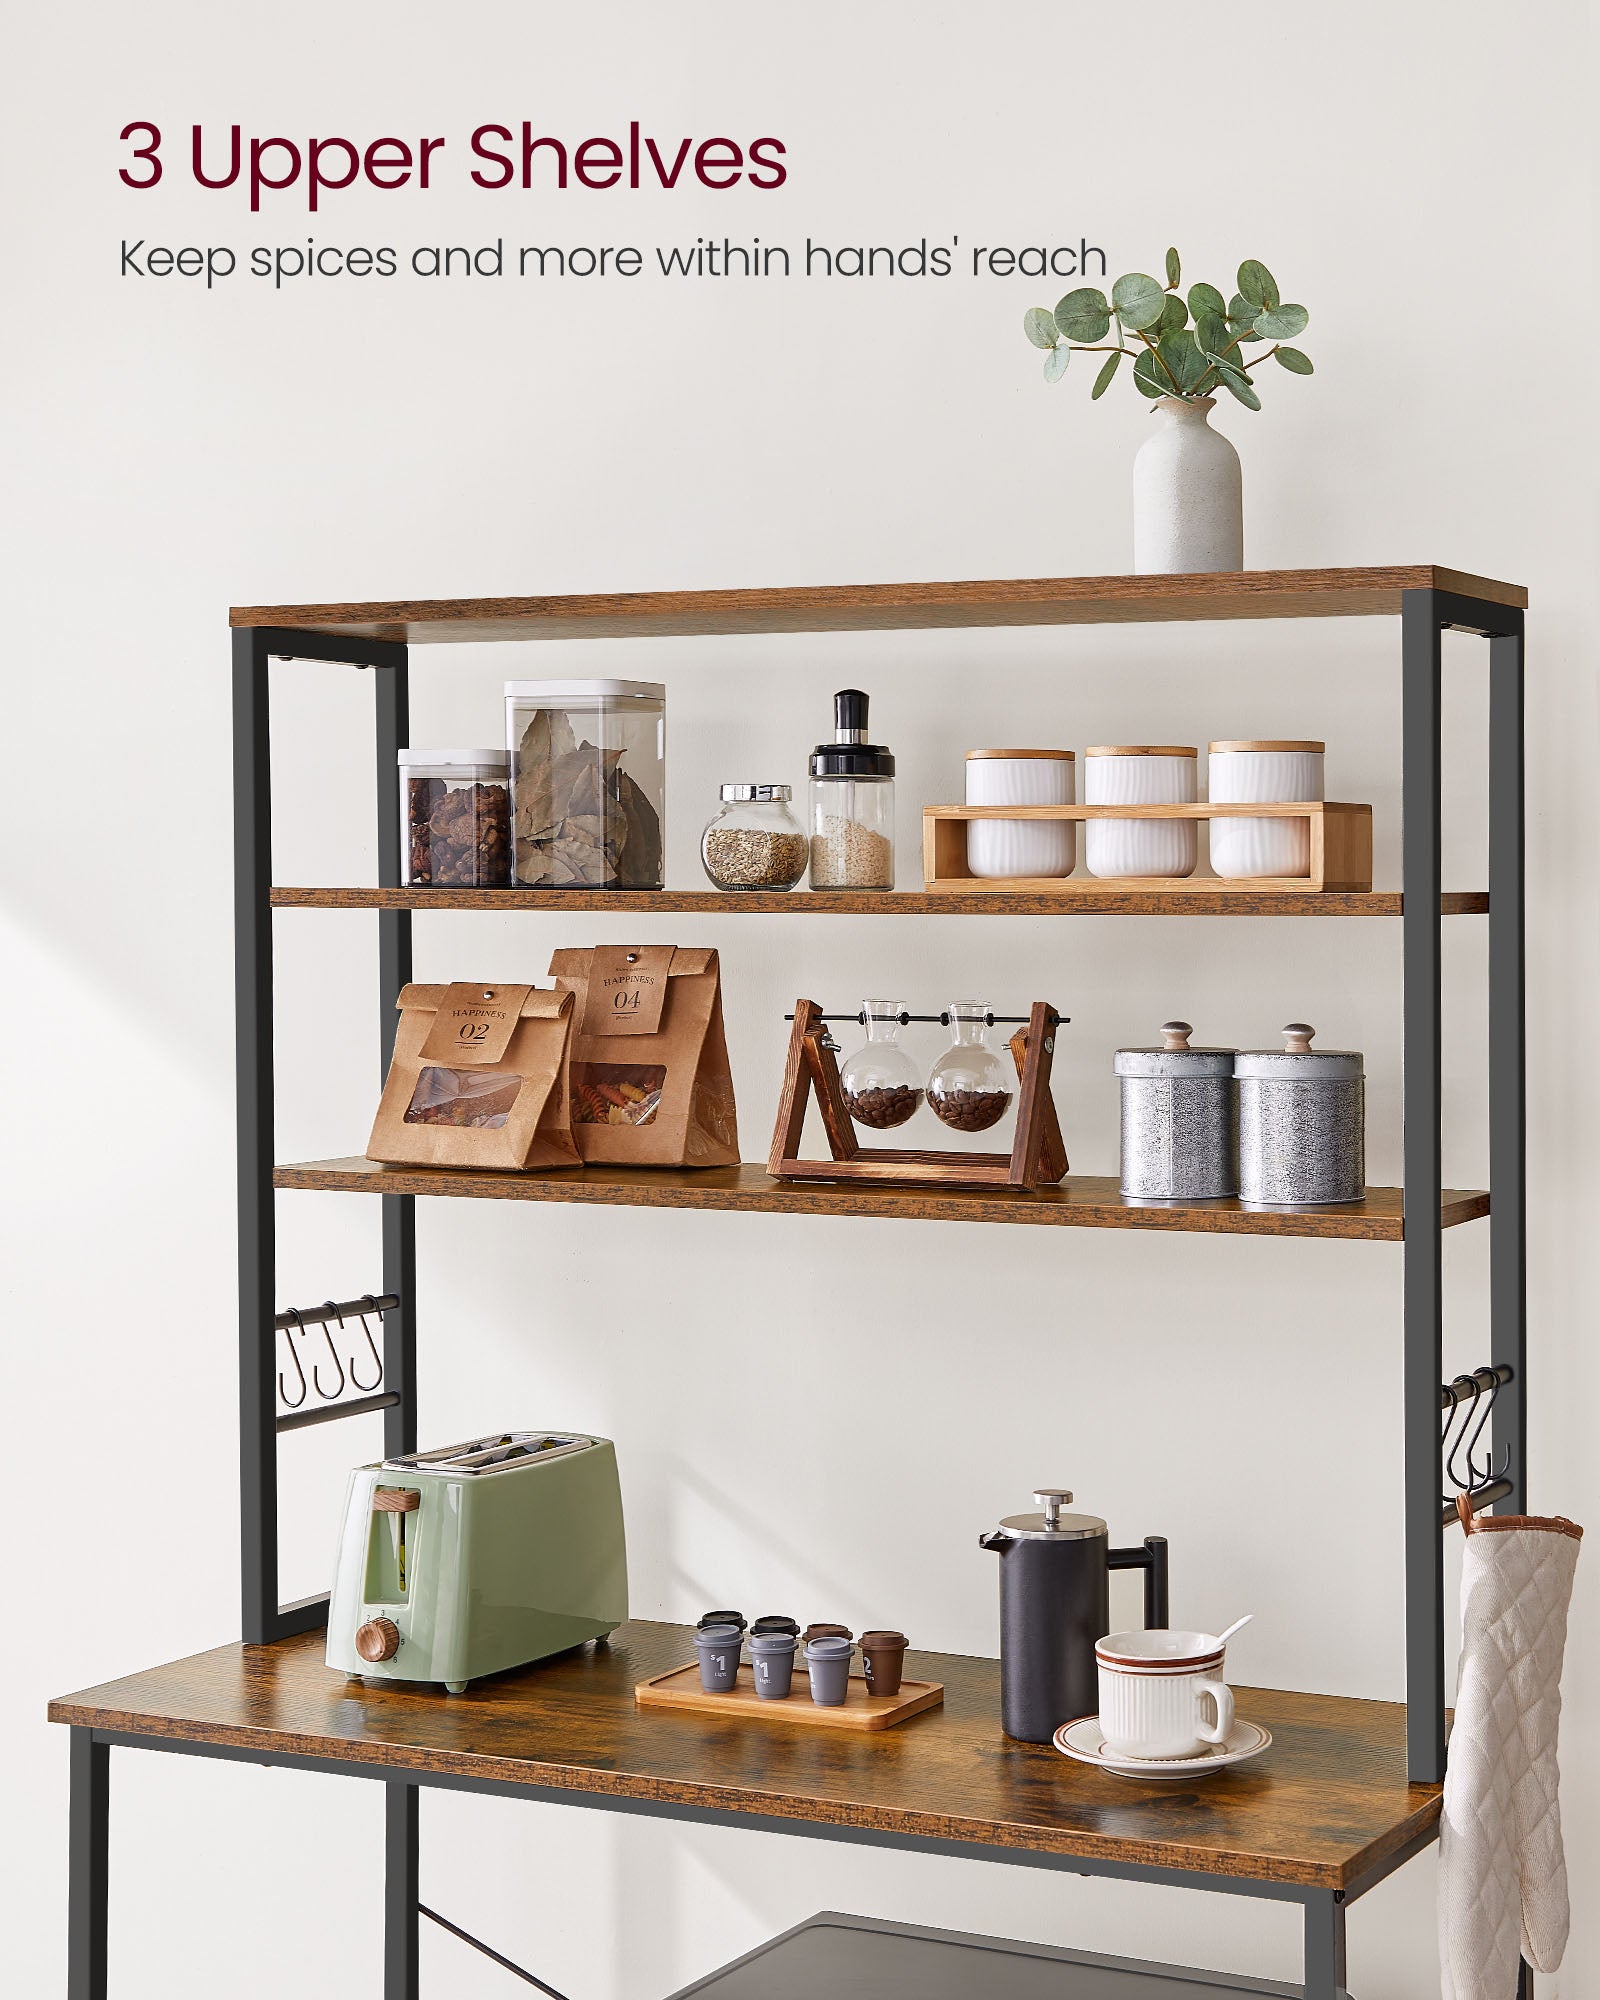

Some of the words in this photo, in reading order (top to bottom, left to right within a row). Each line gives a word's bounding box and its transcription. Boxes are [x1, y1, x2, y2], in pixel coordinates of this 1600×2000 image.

[603, 975, 655, 987] HAPPINESS
[614, 990, 641, 1009] 04
[452, 1009, 507, 1020] HAPPINESS
[459, 1022, 490, 1040] 02
